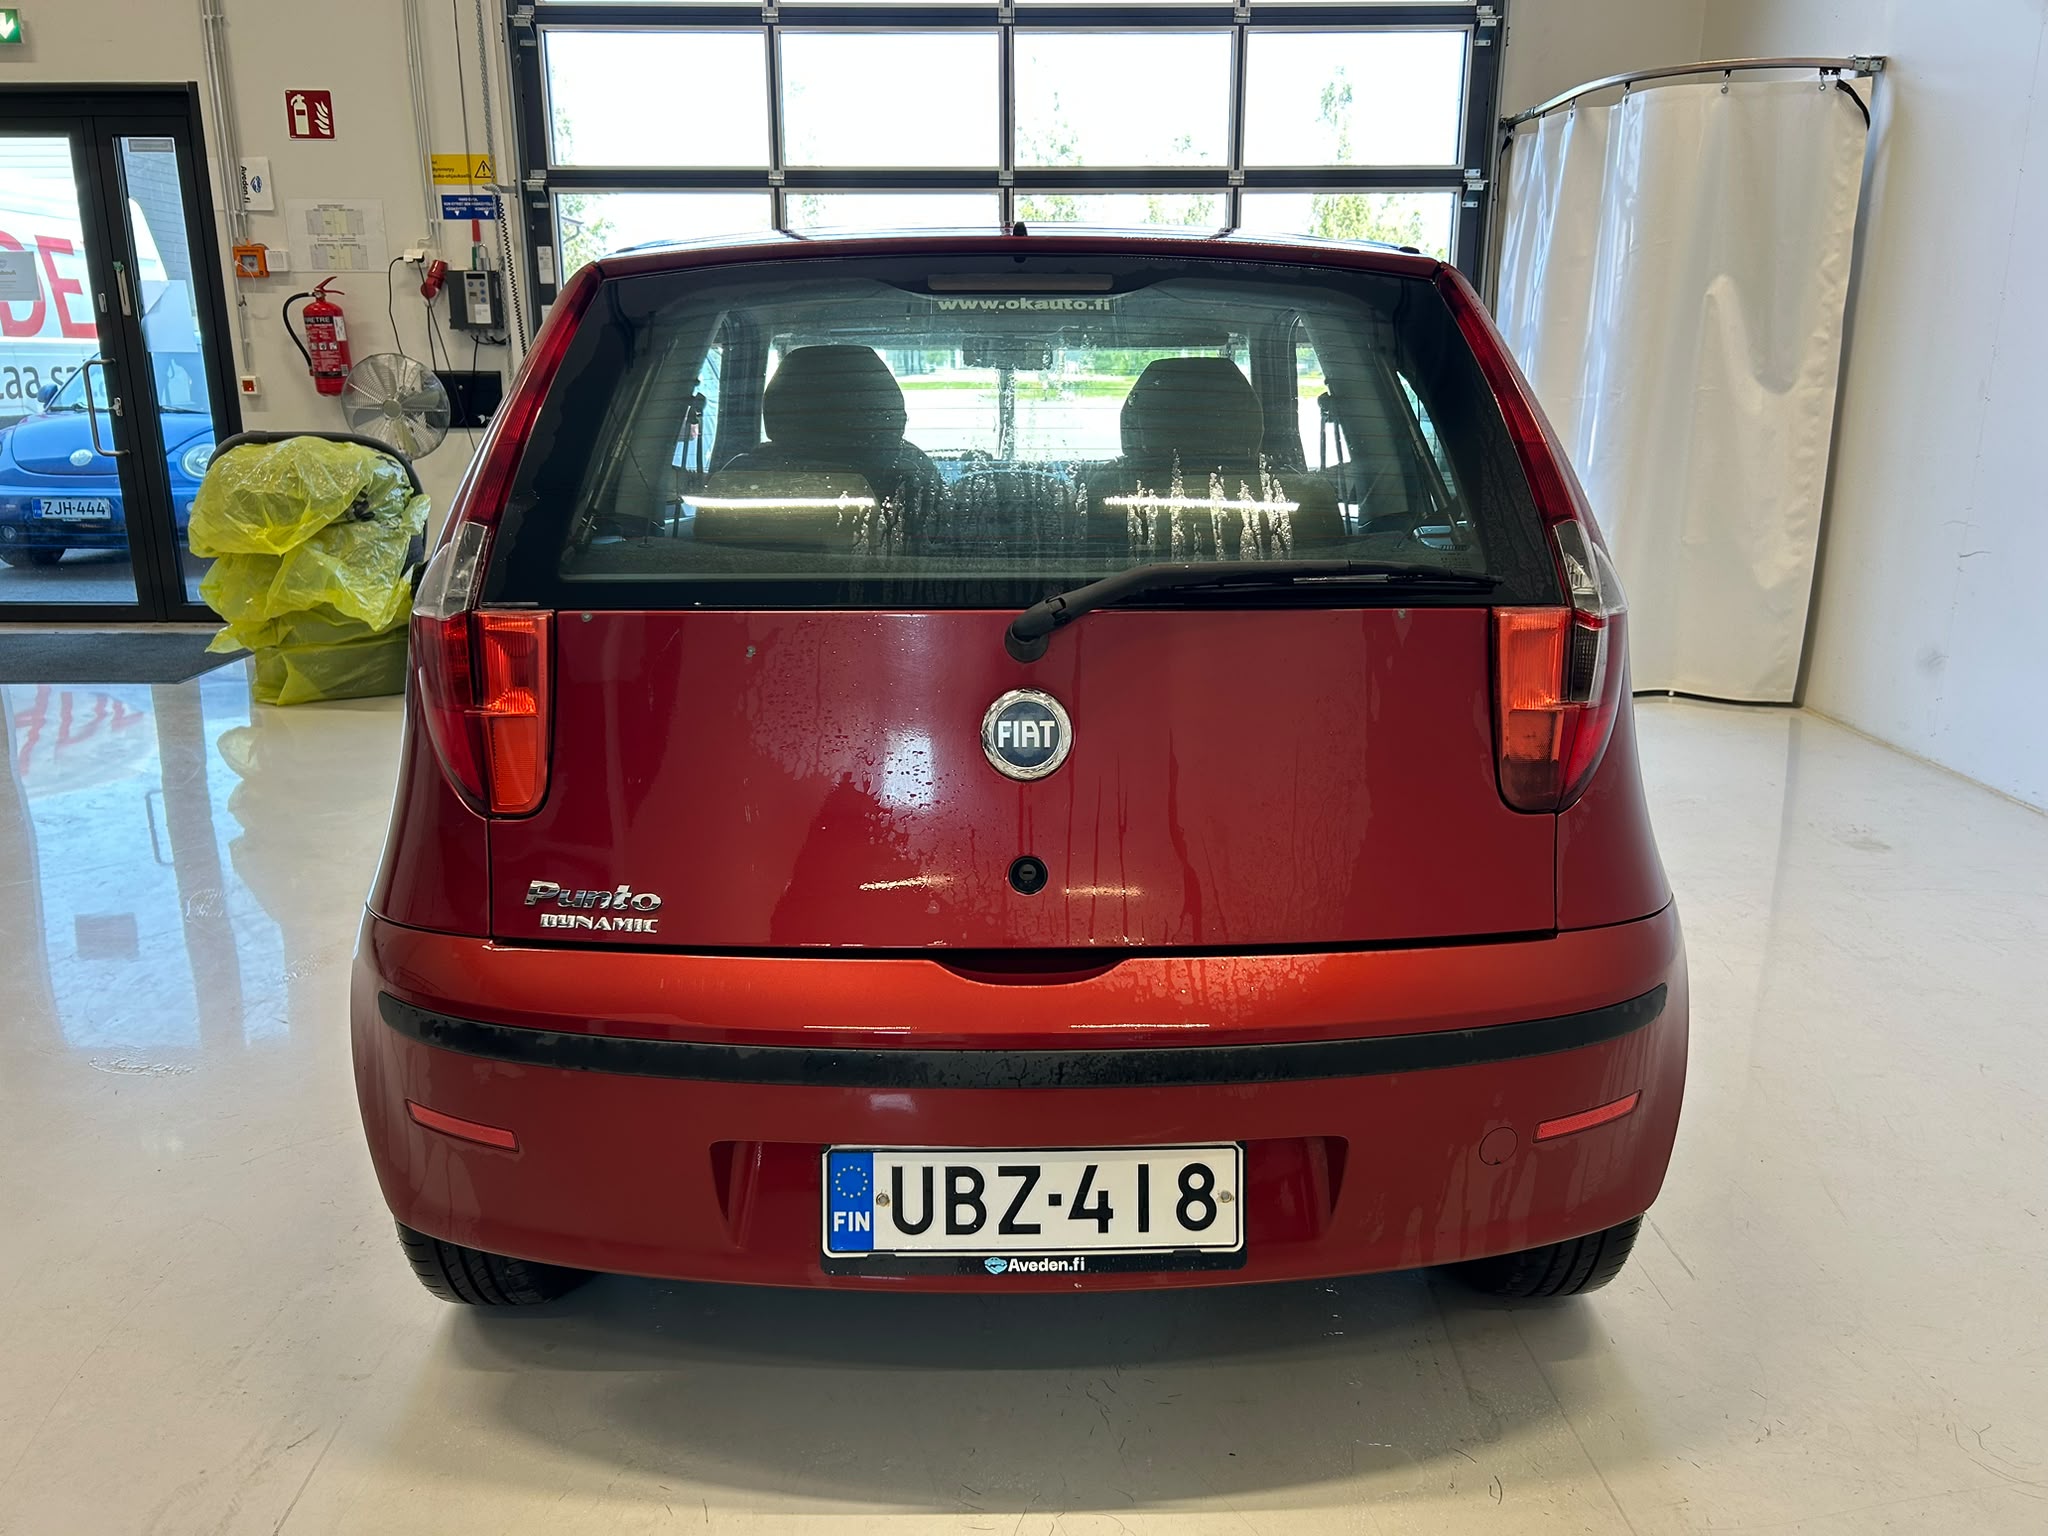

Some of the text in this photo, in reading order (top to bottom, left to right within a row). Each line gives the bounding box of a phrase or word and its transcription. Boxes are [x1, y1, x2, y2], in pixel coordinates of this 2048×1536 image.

[937, 297, 1110, 311] www.okauto.fi
[43, 501, 106, 516] ZJH-444
[997, 720, 1056, 748] FIAT
[524, 880, 662, 911] Punto
[540, 913, 659, 933] DYNAMIC
[832, 1162, 1218, 1236] FIN UBZ-418
[1008, 1256, 1085, 1273] Aveden.fi
